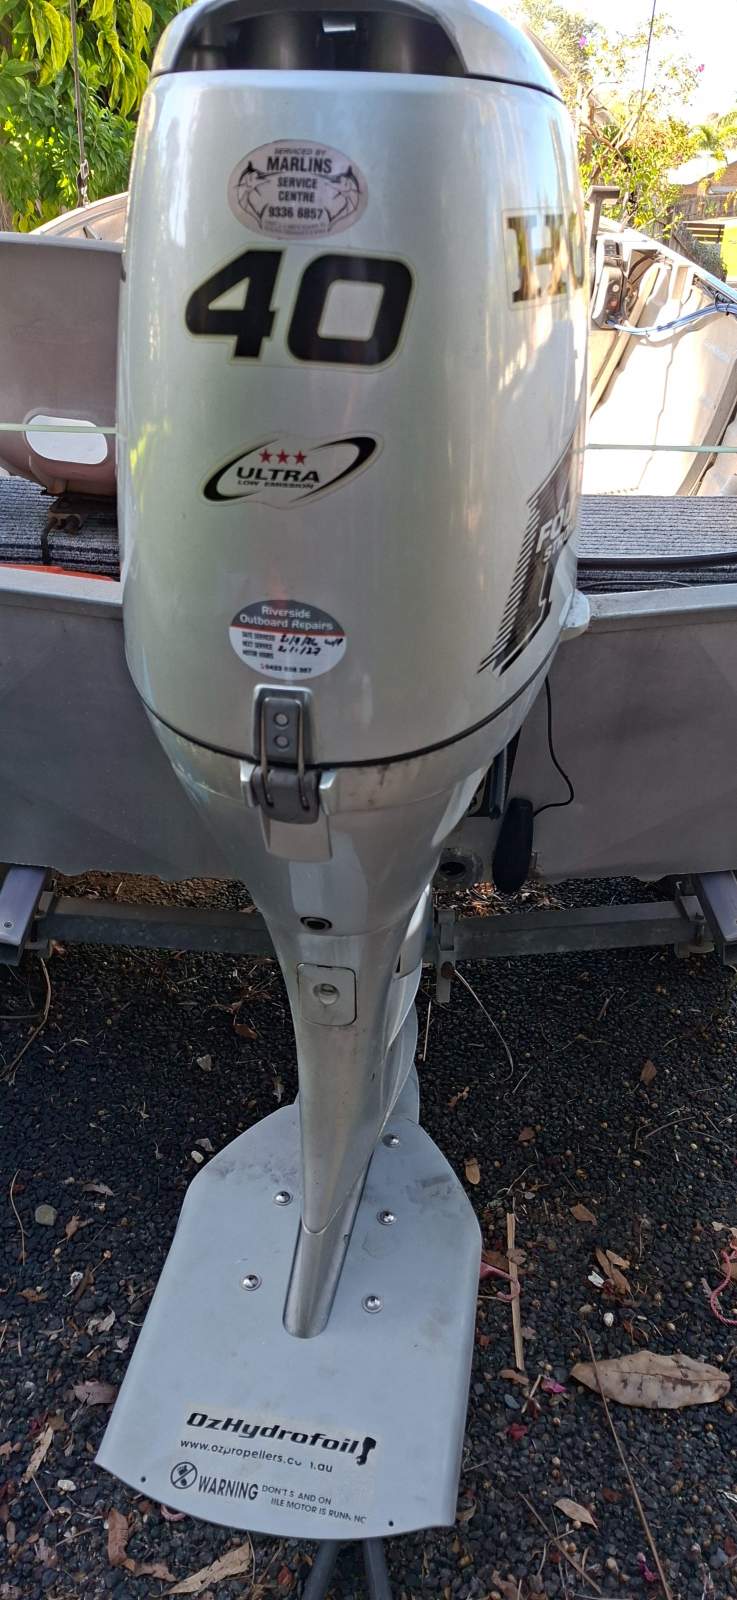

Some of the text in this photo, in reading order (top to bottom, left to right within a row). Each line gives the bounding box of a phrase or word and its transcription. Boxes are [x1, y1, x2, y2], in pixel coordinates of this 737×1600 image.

[274, 148, 313, 156] SERVICED
[266, 156, 332, 174] MARLINS
[276, 177, 318, 189] SERVICE
[278, 190, 315, 203] CENTRE
[268, 206, 294, 218] 9336
[185, 250, 412, 366] 40
[237, 467, 321, 483] ULTRA
[261, 606, 311, 619] Riverside
[240, 614, 333, 631] Outboard Repairs
[186, 1412, 360, 1455] OzHydrofoil
[198, 1475, 259, 1501] WARNING
[318, 1496, 332, 1505] ON
[286, 1500, 317, 1514] MOTOR
[319, 1508, 326, 1516] IS
